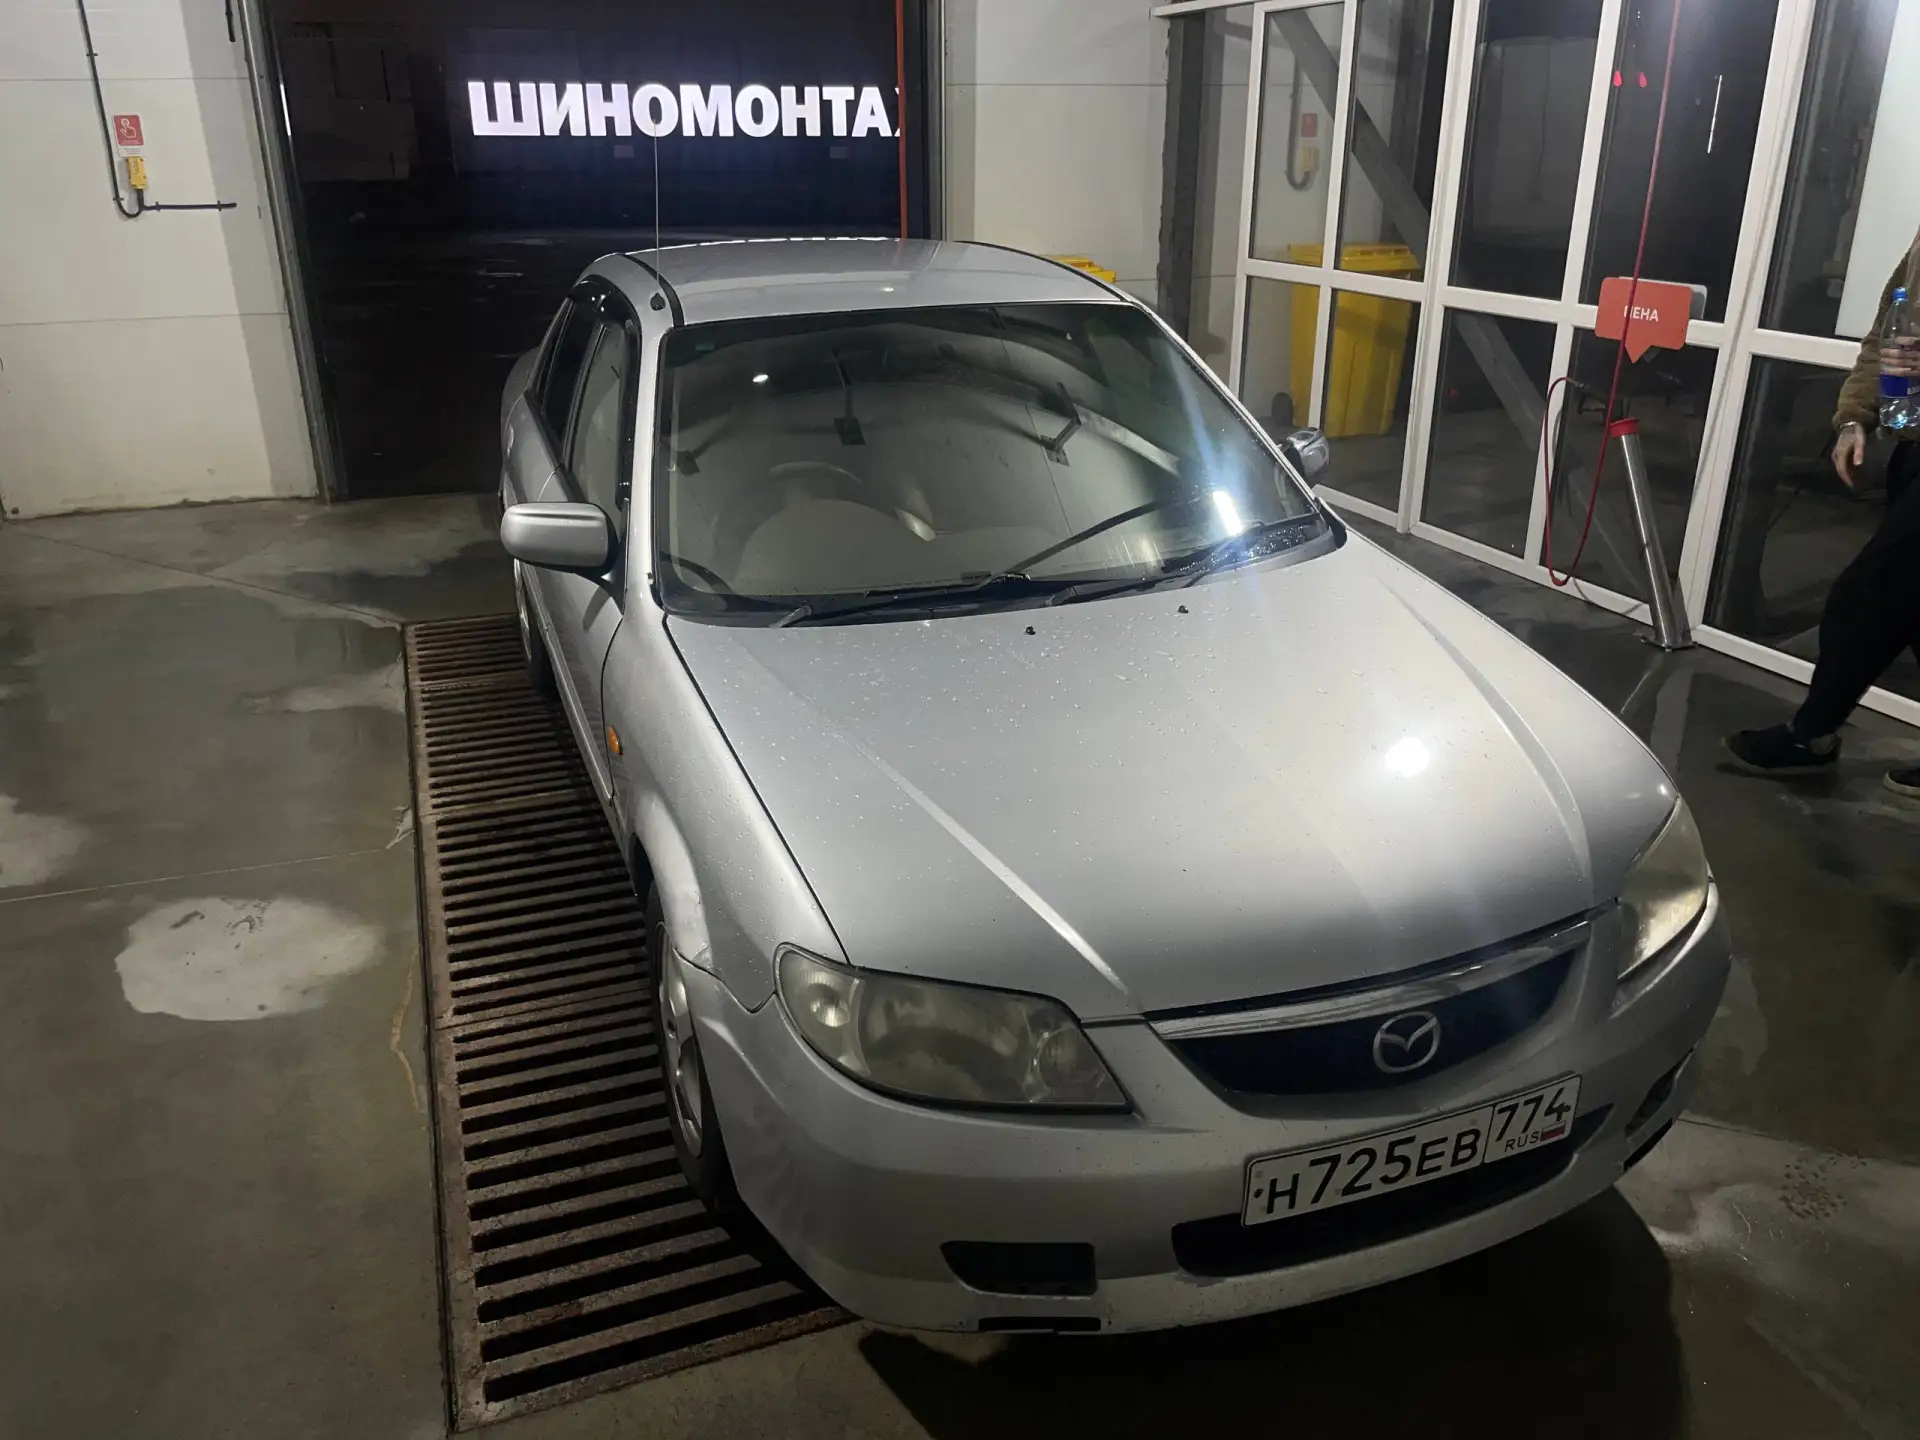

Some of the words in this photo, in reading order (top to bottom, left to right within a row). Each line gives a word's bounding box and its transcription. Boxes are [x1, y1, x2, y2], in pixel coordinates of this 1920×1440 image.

[468, 81, 901, 138] ШИНОМОНТА
[1265, 1128, 1482, 1215] Н725ЕВ
[1494, 1087, 1571, 1143] 774
[1504, 1131, 1540, 1153] RUS
